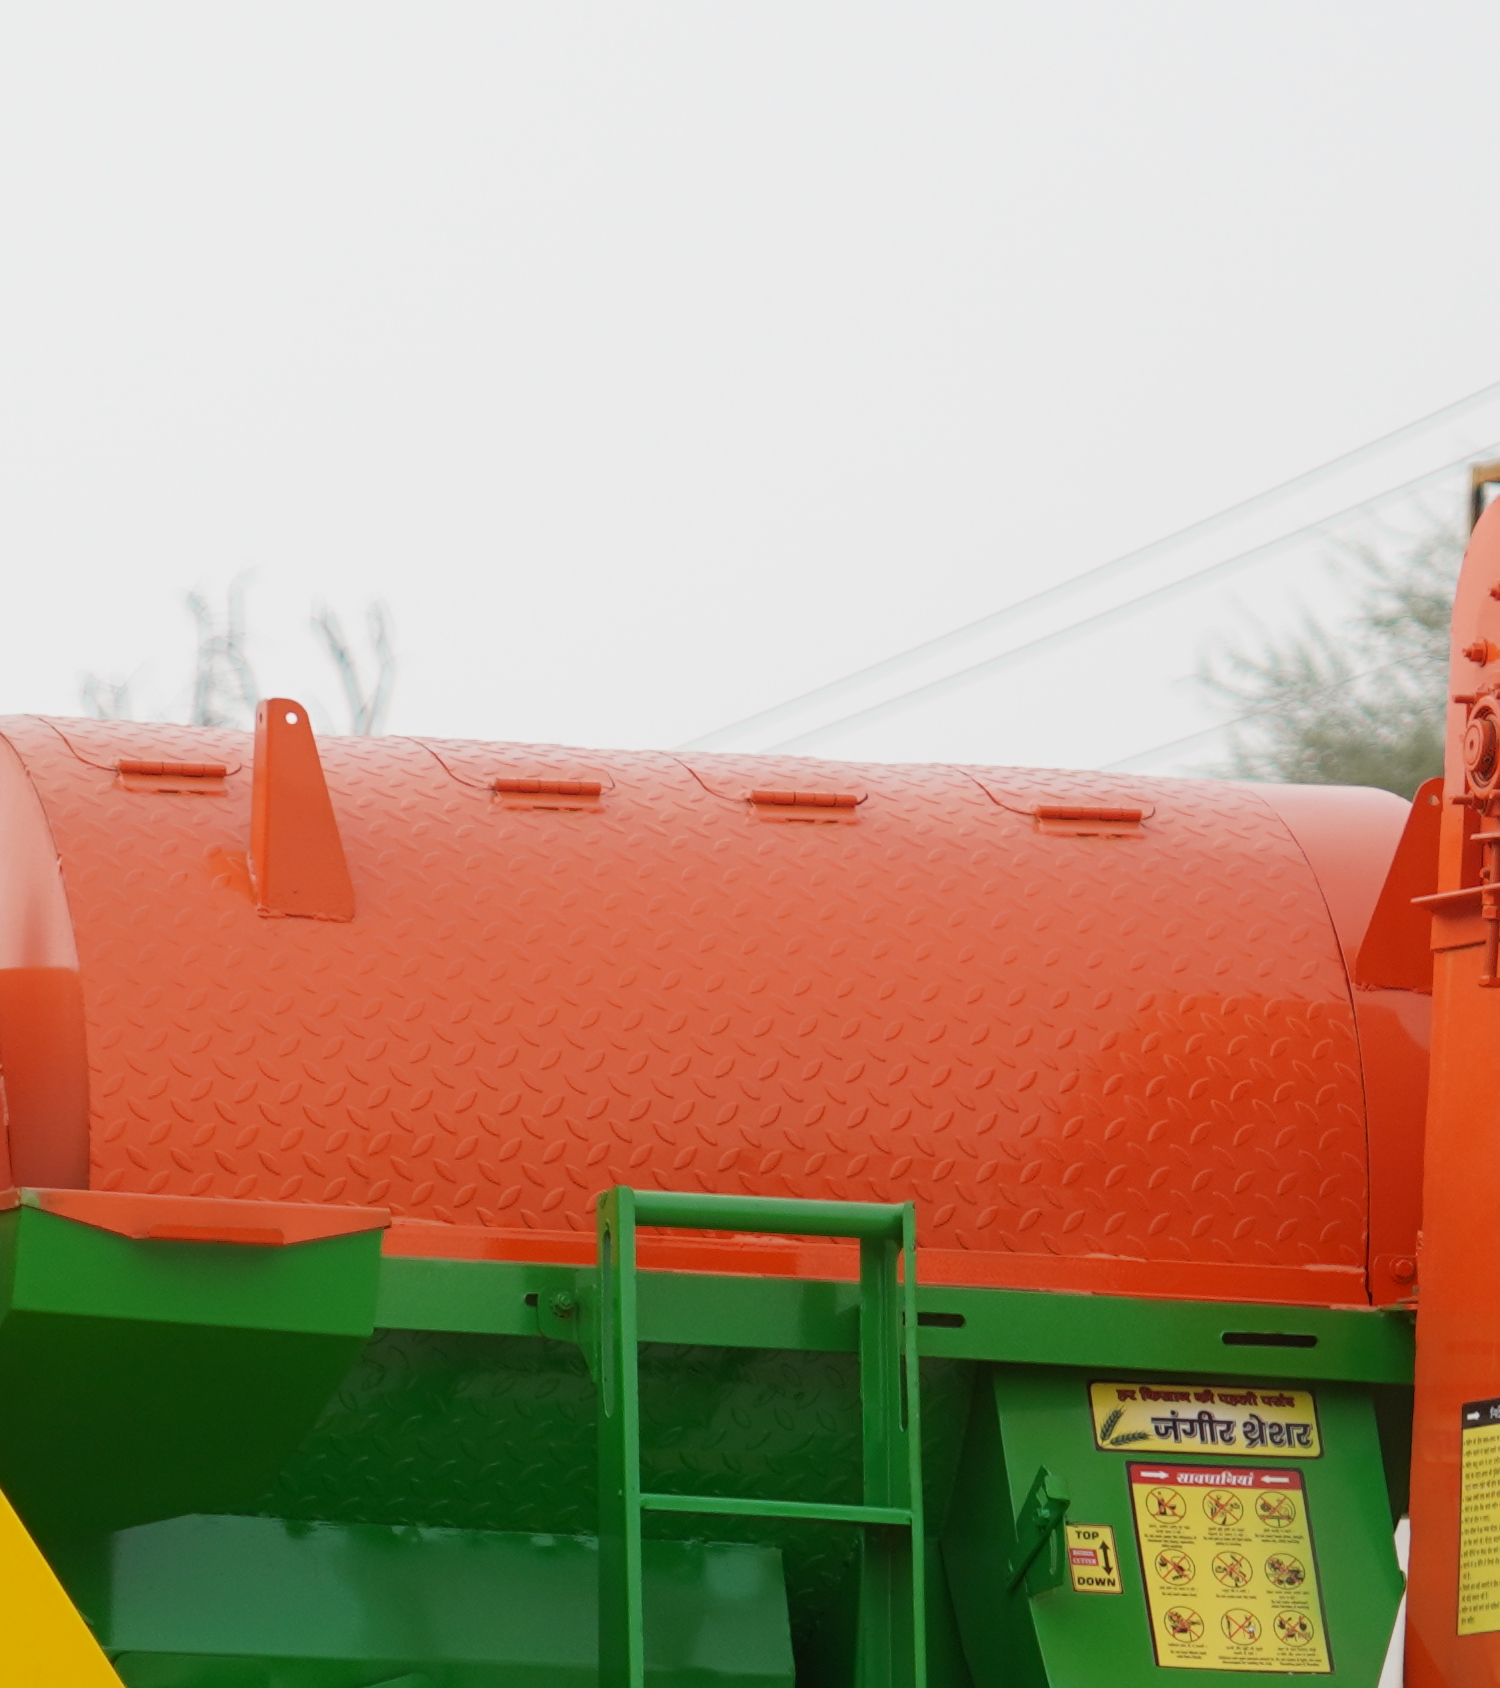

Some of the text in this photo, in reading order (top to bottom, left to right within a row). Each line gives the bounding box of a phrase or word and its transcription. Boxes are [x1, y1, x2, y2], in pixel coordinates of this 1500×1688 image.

[1151, 1410, 1313, 1448] जंगीर थ्रेशर
[1075, 1530, 1100, 1540] TOP
[1077, 1576, 1116, 1587] DOWN
